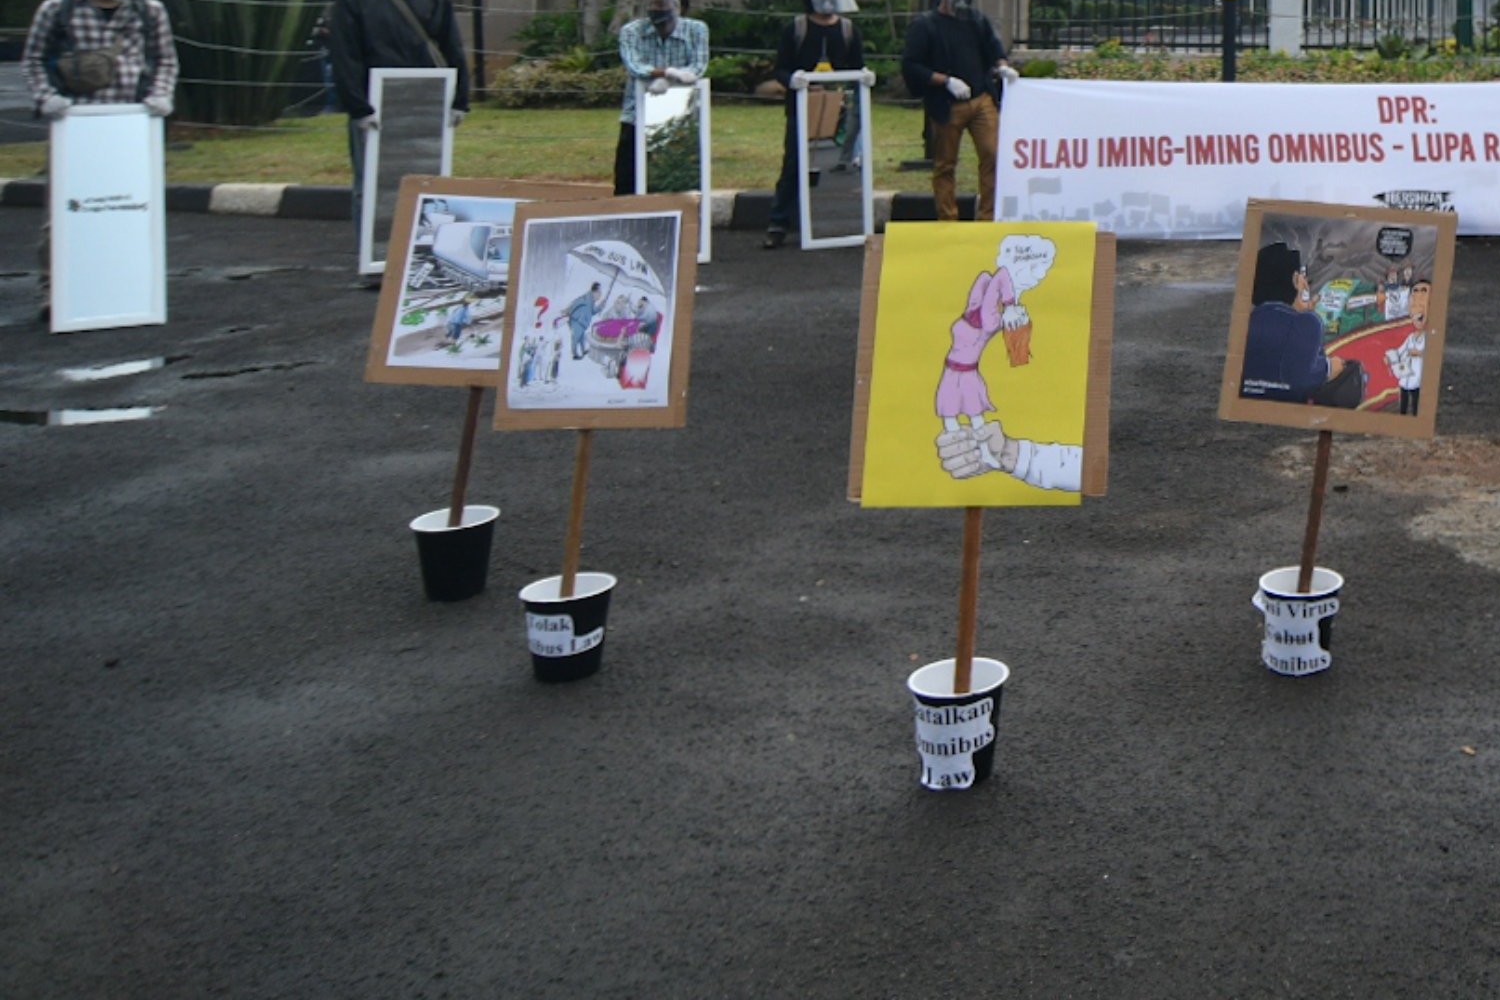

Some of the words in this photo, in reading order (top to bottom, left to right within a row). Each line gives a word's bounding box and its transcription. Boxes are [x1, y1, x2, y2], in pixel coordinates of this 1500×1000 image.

[1377, 96, 1437, 124] DPR:
[1013, 138, 1088, 169] SILAU
[1097, 134, 1260, 168] IMING-IMING
[1268, 132, 1385, 164] OMNIBUS
[1412, 132, 1476, 163] LUPA
[1286, 599, 1337, 619] Virus
[916, 700, 992, 726] atalkan
[918, 729, 993, 757] mnibus
[926, 766, 971, 787] Law
